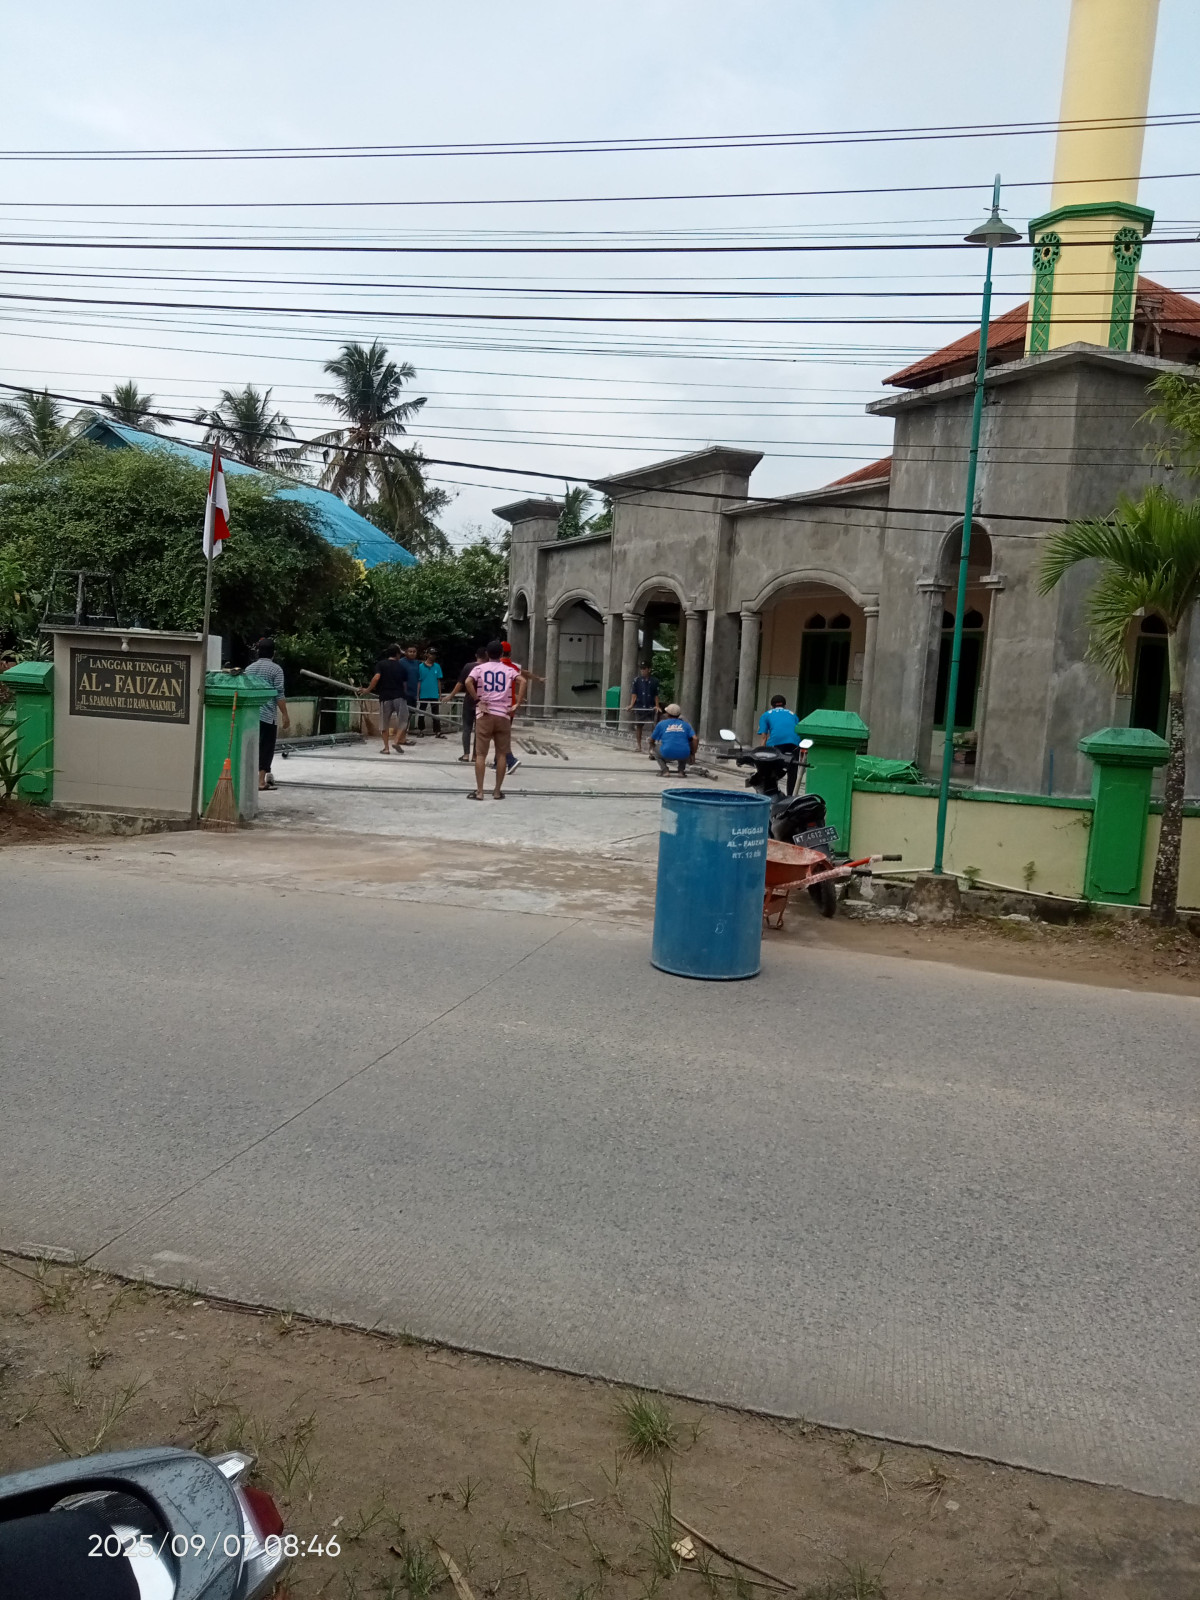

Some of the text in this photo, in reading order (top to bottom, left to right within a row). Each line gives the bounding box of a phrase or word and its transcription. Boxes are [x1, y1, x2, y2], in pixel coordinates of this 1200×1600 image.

[89, 658, 172, 674] LANGGAR TENGAH
[79, 672, 102, 691] AL
[114, 674, 182, 697] FAUZAN
[483, 670, 506, 692] 99
[726, 840, 738, 848] AL
